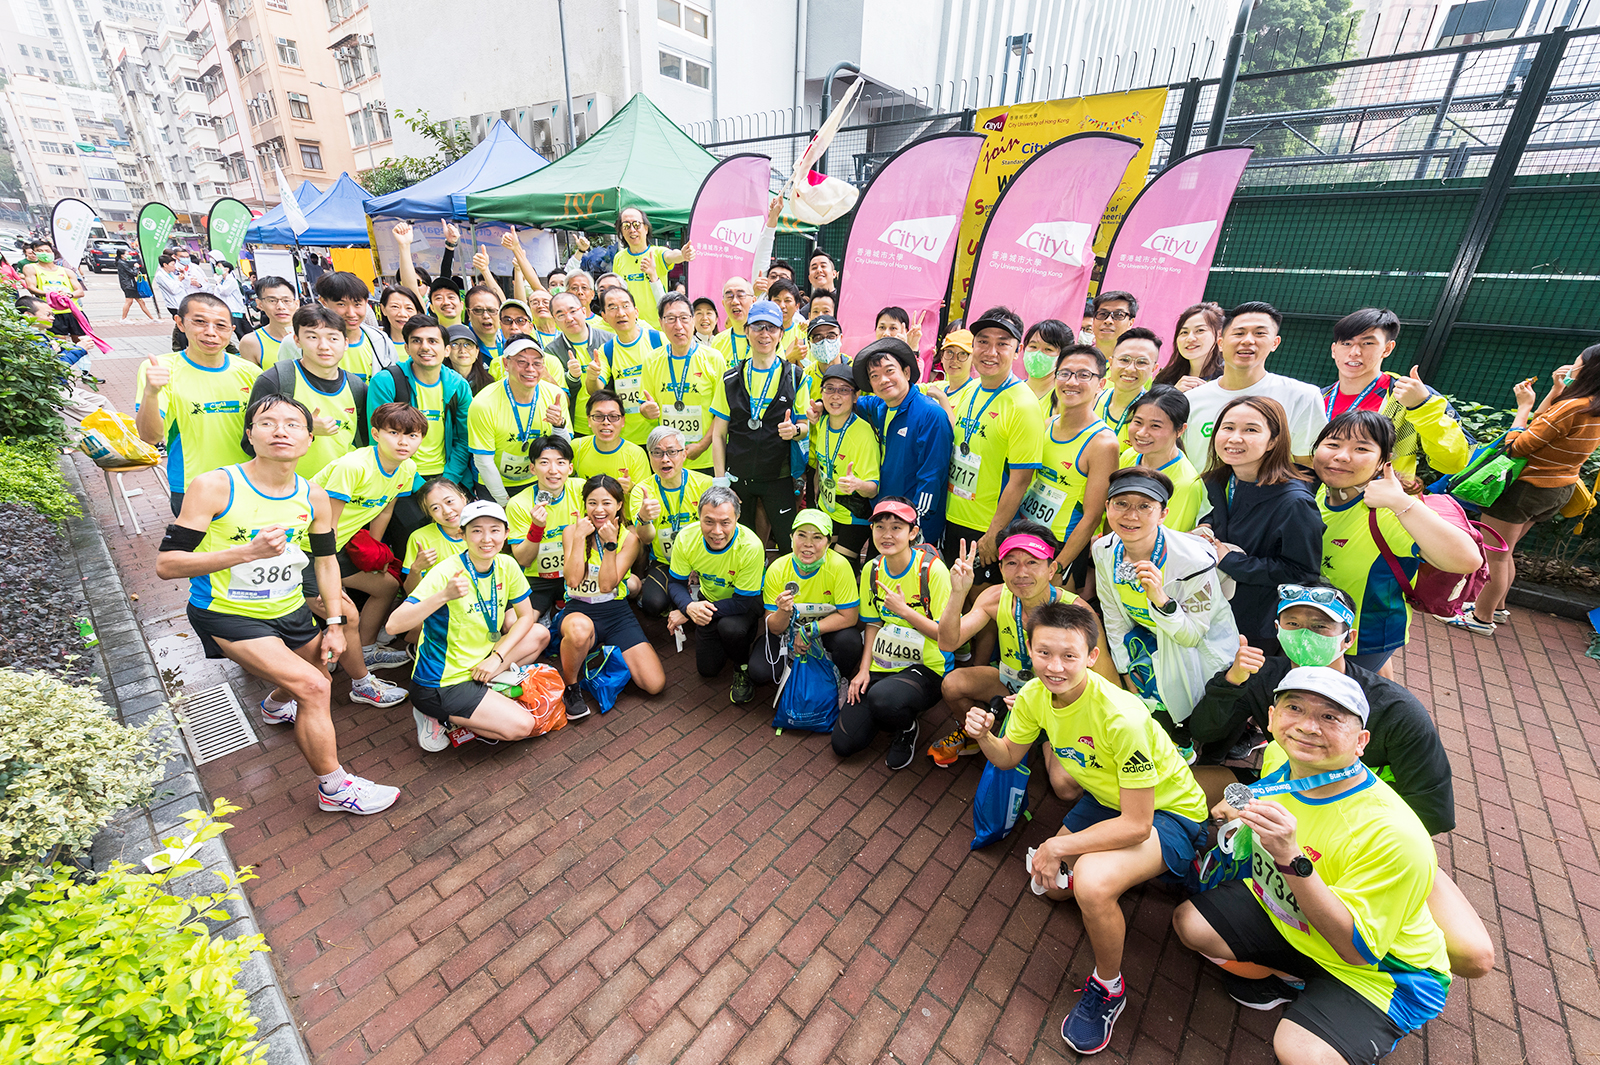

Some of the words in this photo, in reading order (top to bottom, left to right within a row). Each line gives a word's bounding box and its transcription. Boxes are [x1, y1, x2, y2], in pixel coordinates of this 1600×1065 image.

[983, 136, 1020, 174] join
[717, 227, 752, 246] CityU
[887, 229, 937, 253] CityU
[1026, 232, 1074, 258] CityU
[1151, 235, 1198, 257] CityU
[857, 248, 904, 261] 香港城市大學
[866, 258, 888, 268] University
[895, 262, 908, 270] Hong
[992, 250, 1042, 267] 香港城市大學
[1120, 254, 1166, 264] 香港城市大學
[989, 260, 1000, 269] City
[1000, 263, 1025, 273] University
[1032, 268, 1047, 277] Hong
[1022, 495, 1054, 523] A2950
[252, 565, 291, 585] 386
[874, 638, 920, 660] M4498
[1329, 767, 1355, 780] Standard
[1265, 783, 1292, 793] Standard
[1254, 852, 1300, 913] 3734
